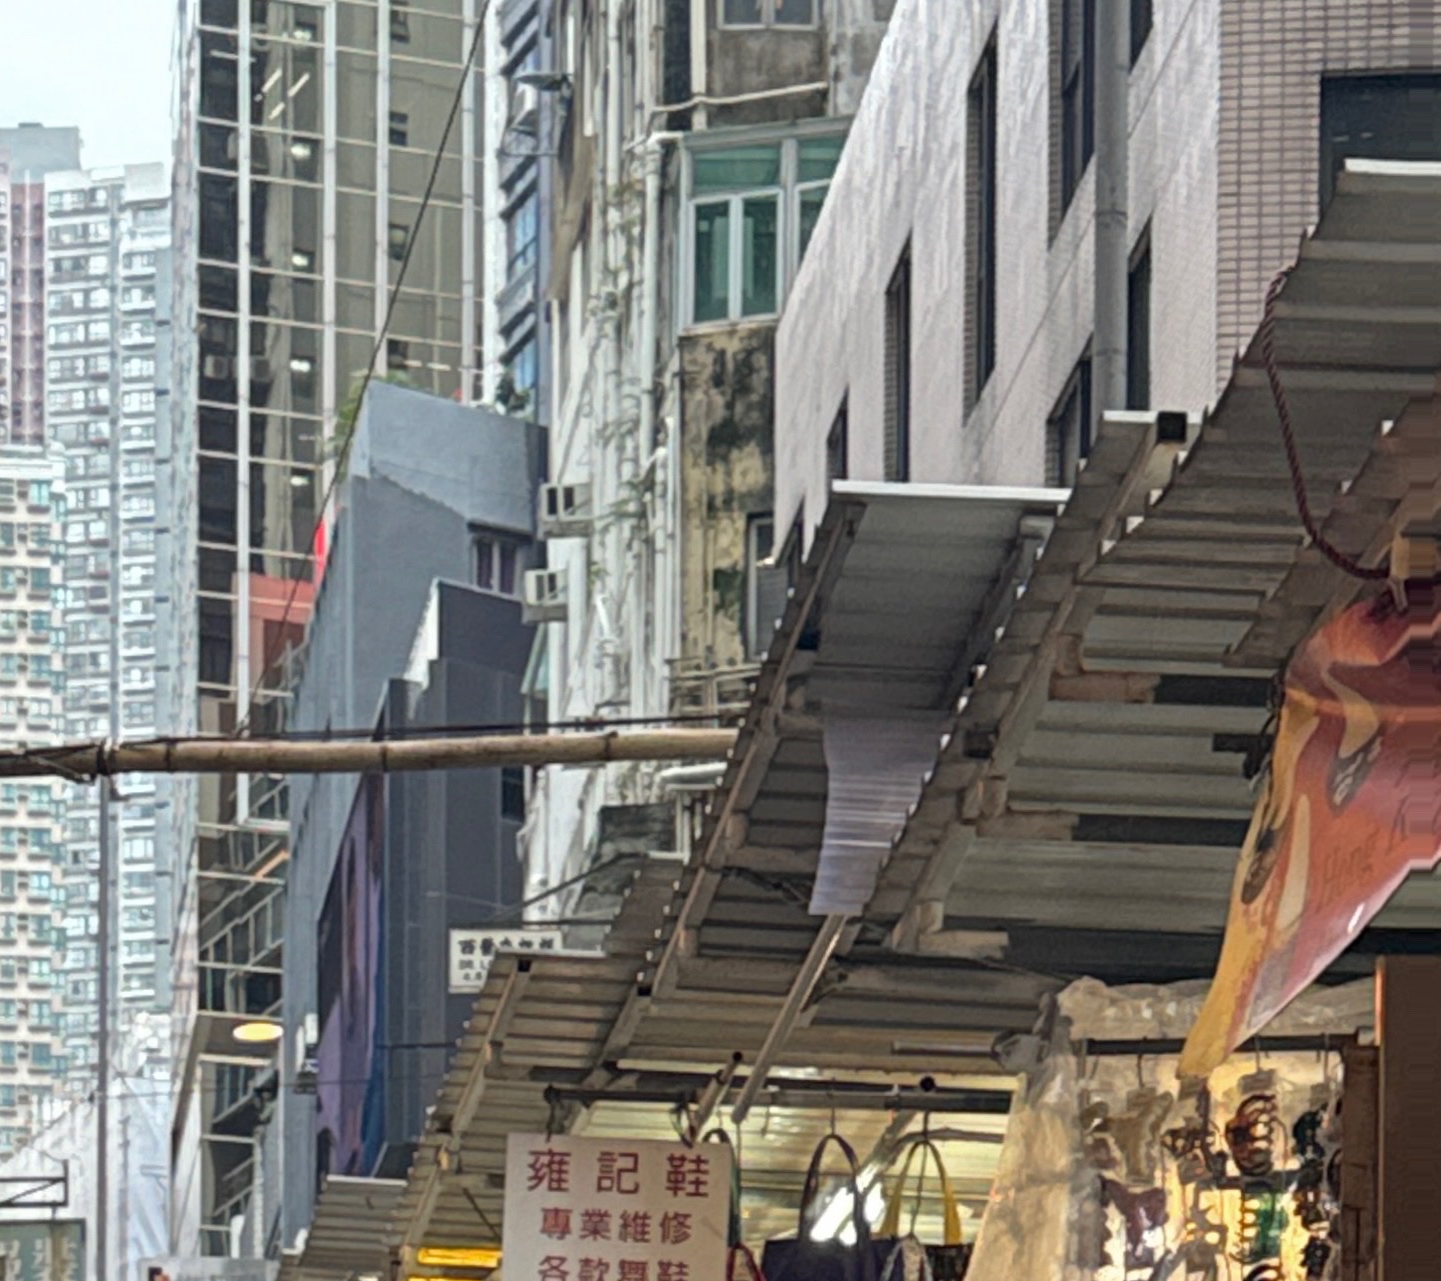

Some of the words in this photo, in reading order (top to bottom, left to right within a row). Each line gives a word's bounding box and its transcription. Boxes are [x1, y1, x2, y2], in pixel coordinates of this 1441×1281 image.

[526, 1148, 710, 1199] 雍記鞋
[539, 1207, 693, 1245] 專業維修
